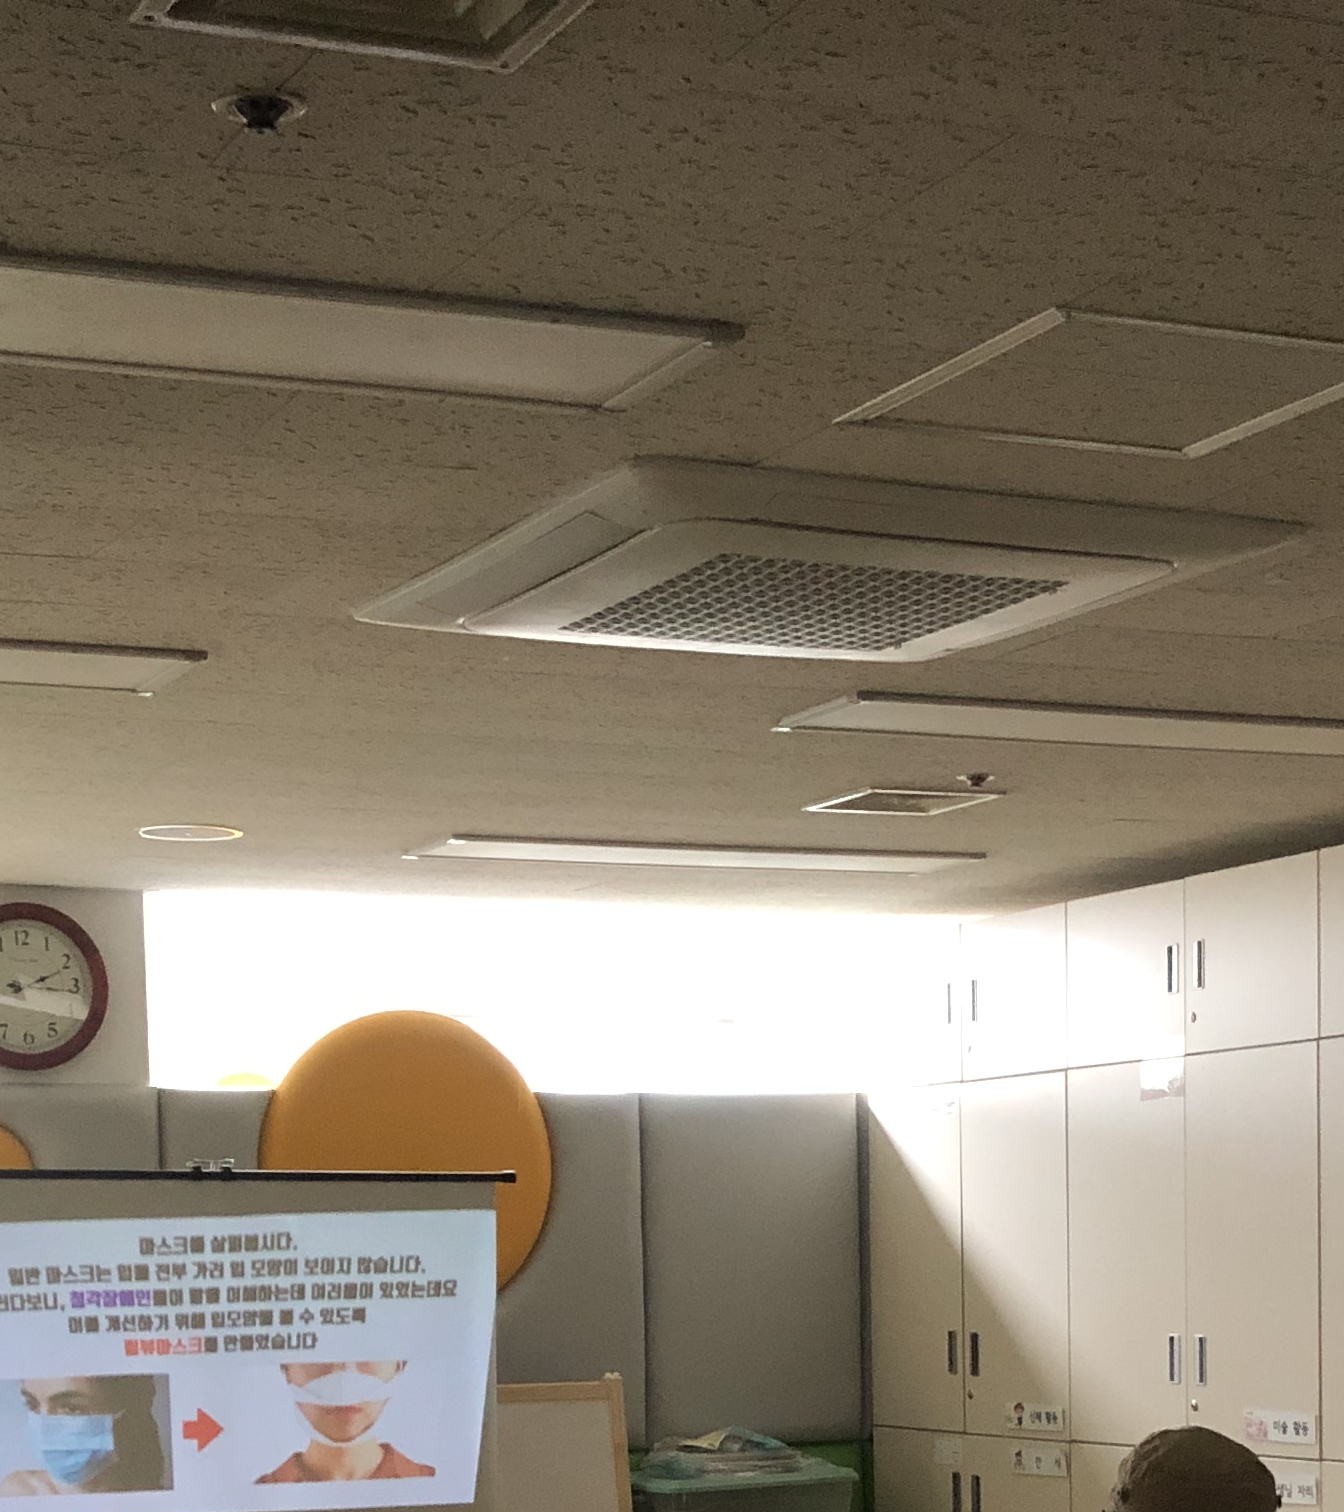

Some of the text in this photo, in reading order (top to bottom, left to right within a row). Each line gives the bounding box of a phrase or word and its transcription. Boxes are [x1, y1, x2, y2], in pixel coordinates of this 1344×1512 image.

[14, 930, 30, 945] 12
[61, 953, 71, 969] 2
[70, 977, 80, 994] 3
[22, 1030, 35, 1045] 6
[47, 1022, 58, 1038] 5
[139, 1235, 205, 1256] 마스크를
[8, 1265, 41, 1286] 일반
[45, 1264, 112, 1284] 마스크는
[155, 1261, 188, 1281] 전부
[250, 1257, 298, 1277] 모양이
[303, 1256, 352, 1276] 보이지
[226, 1283, 306, 1303] 이해하는데
[379, 1279, 458, 1299] 있었는데요
[105, 1313, 170, 1333] 개선하기
[299, 1307, 315, 1324] 수
[319, 1306, 367, 1325] 있도록
[1272, 1420, 1309, 1437] 미술 활동
[1276, 1482, 1293, 1498] 생님
